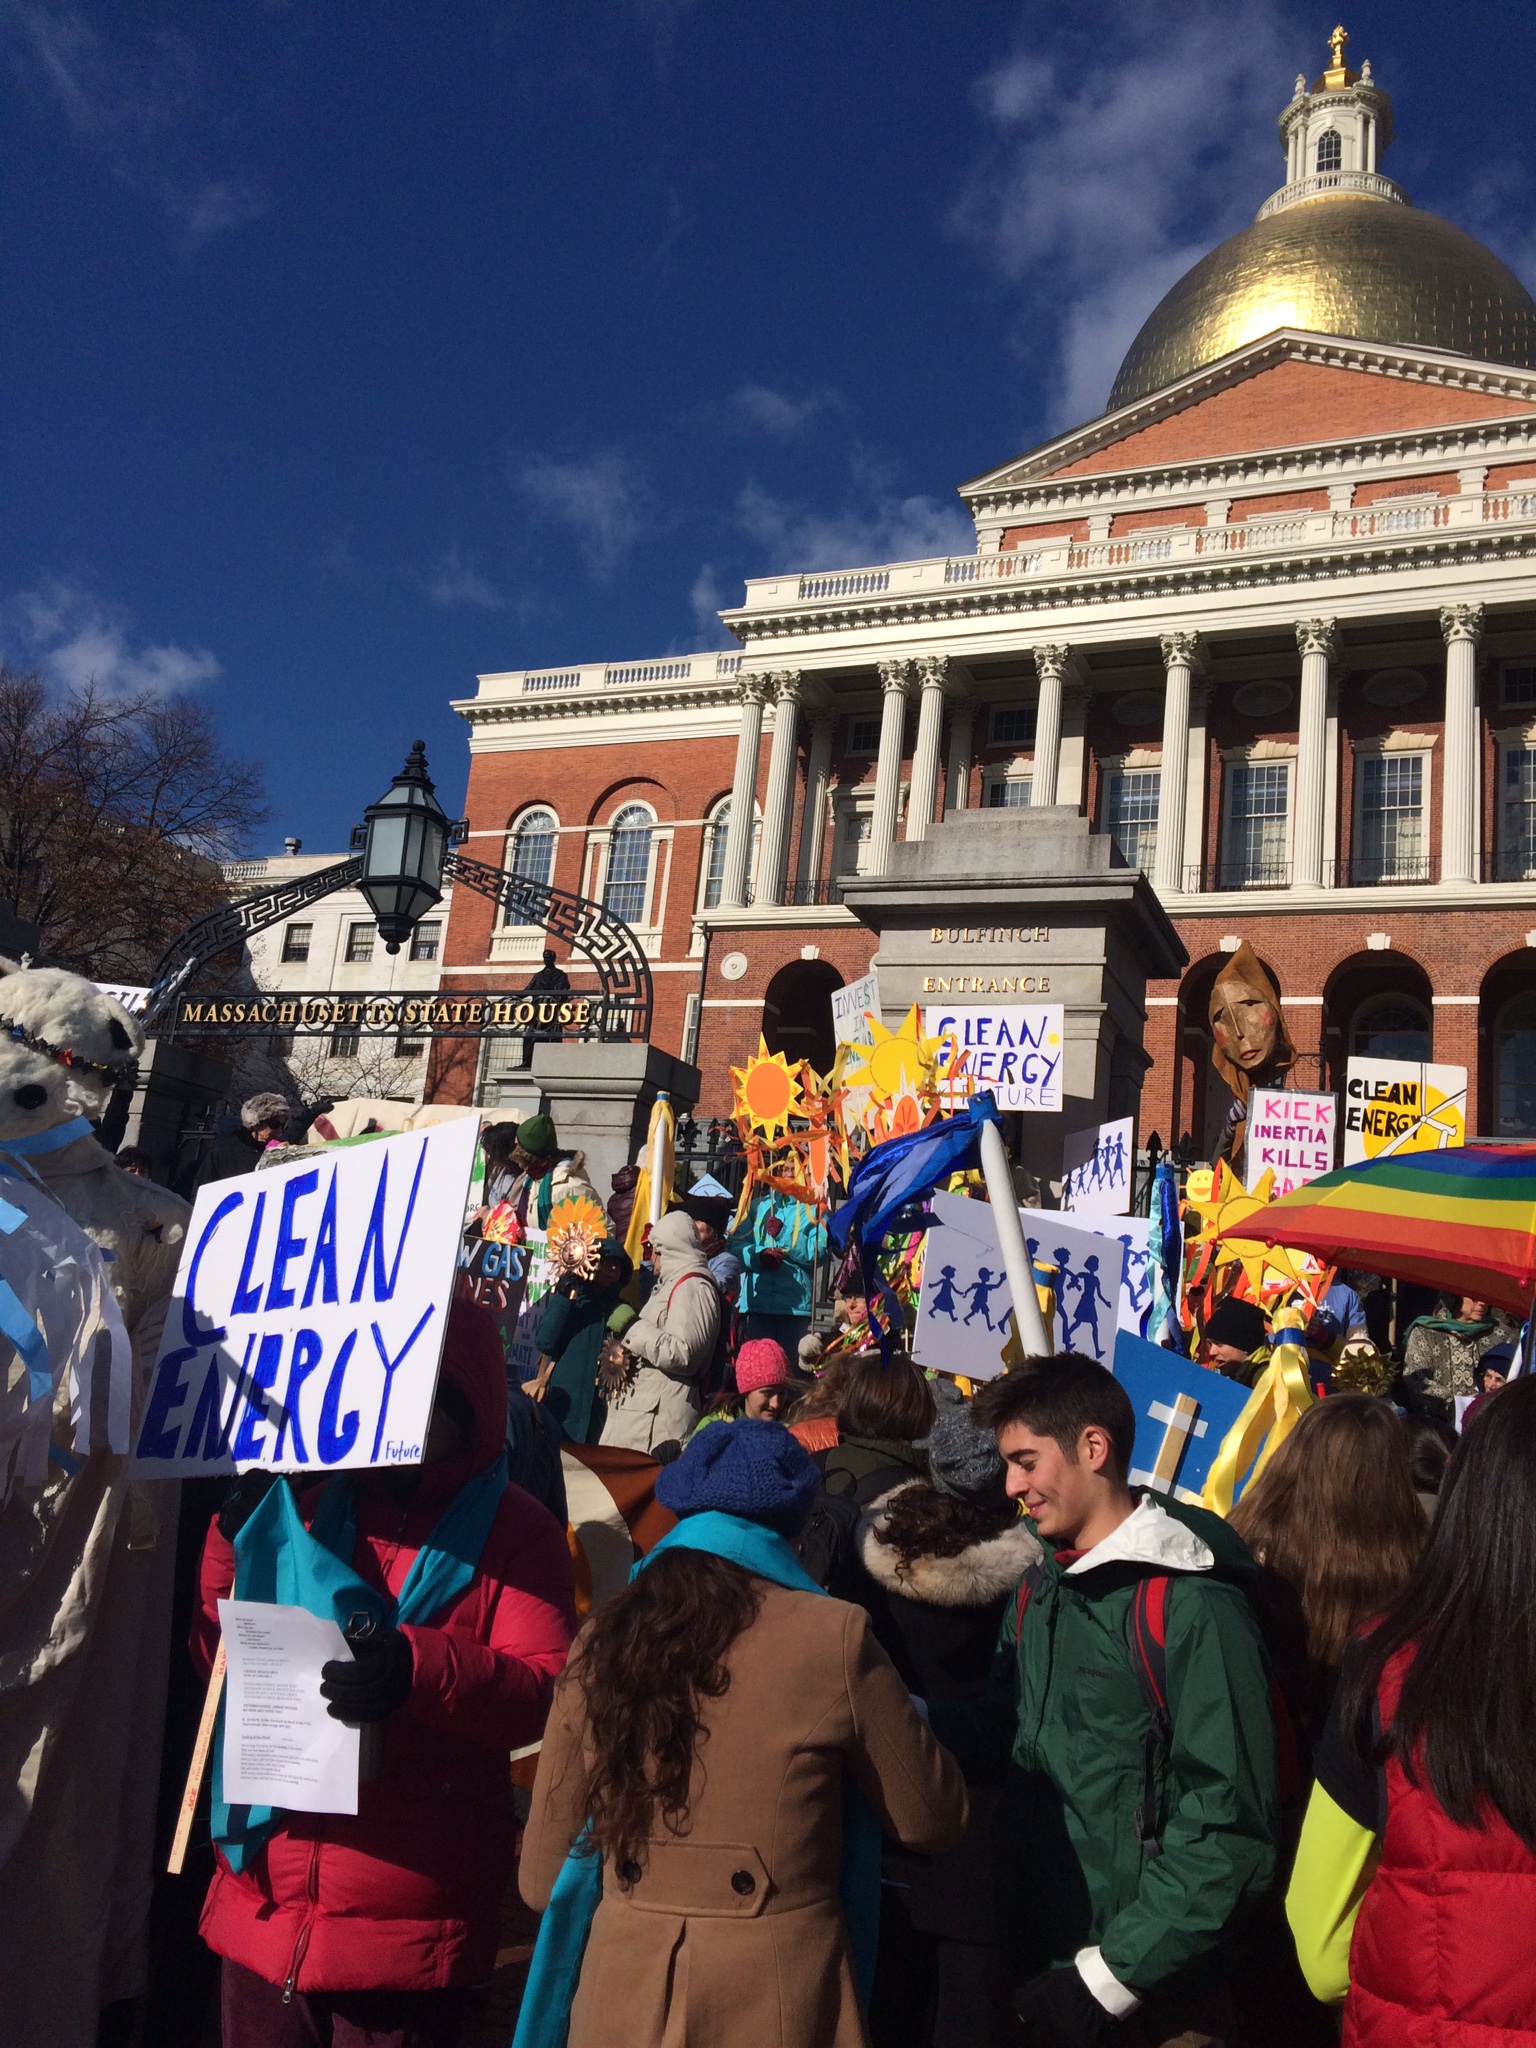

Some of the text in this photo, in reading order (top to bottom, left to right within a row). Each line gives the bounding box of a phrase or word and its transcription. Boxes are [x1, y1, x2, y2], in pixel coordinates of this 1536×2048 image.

[930, 926, 1050, 943] BULFINCH
[923, 976, 1050, 993] ENTRANCE
[182, 1002, 591, 1024] MASSACHUSETTS STATE HOUSE
[938, 1016, 1048, 1048] CLEAN
[1348, 1078, 1417, 1106] CLEAN
[1265, 1099, 1332, 1124] KICK
[1346, 1107, 1422, 1140] ENERGY
[1254, 1124, 1327, 1144] INERTIA
[1262, 1148, 1328, 1171] KILLS
[183, 1136, 429, 1347] CLEAN
[482, 1242, 527, 1281] GAS
[136, 1302, 436, 1465] ENERGY
[385, 1440, 421, 1462] Future
[188, 1788, 198, 1812] ACE
